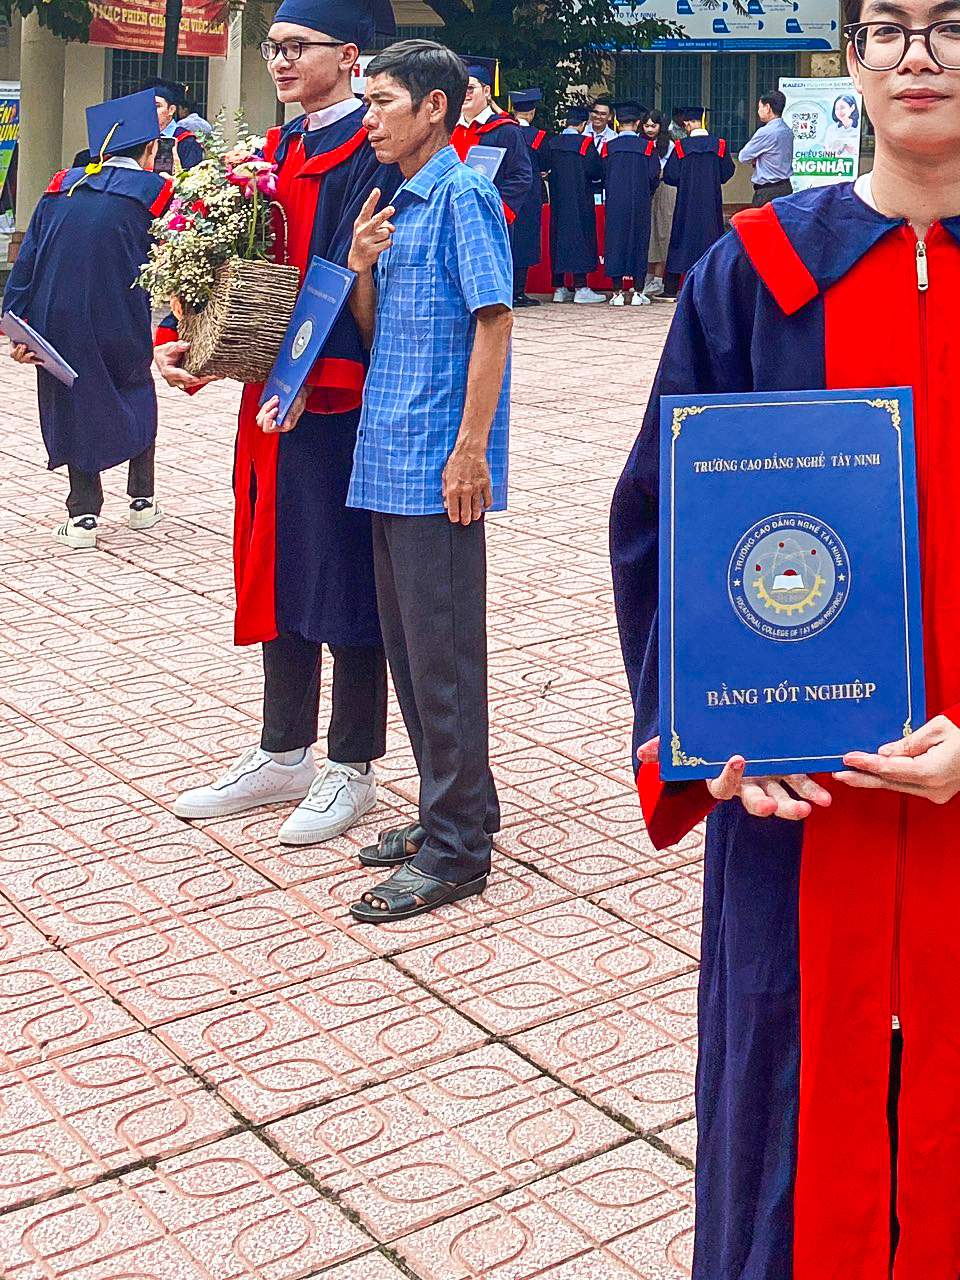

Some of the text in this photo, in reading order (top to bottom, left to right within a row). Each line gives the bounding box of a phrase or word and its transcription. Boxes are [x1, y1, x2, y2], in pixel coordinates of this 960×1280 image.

[818, 150, 836, 158] SINH
[817, 158, 853, 177] NHẬT
[693, 457, 738, 473] TRƯỜNG
[739, 458, 762, 471] CAO
[763, 452, 794, 470] ĐẲNG
[830, 452, 852, 468] TÂY
[853, 453, 881, 467] NINH
[754, 524, 771, 538] CAO
[830, 545, 844, 568] NINH
[735, 594, 762, 630] VOCATIONAL
[760, 624, 790, 638] COLLEGE
[789, 627, 799, 637] OF
[823, 591, 845, 620] PROVINCE
[706, 678, 877, 707] BẰNG TỐT NGHIỆP
